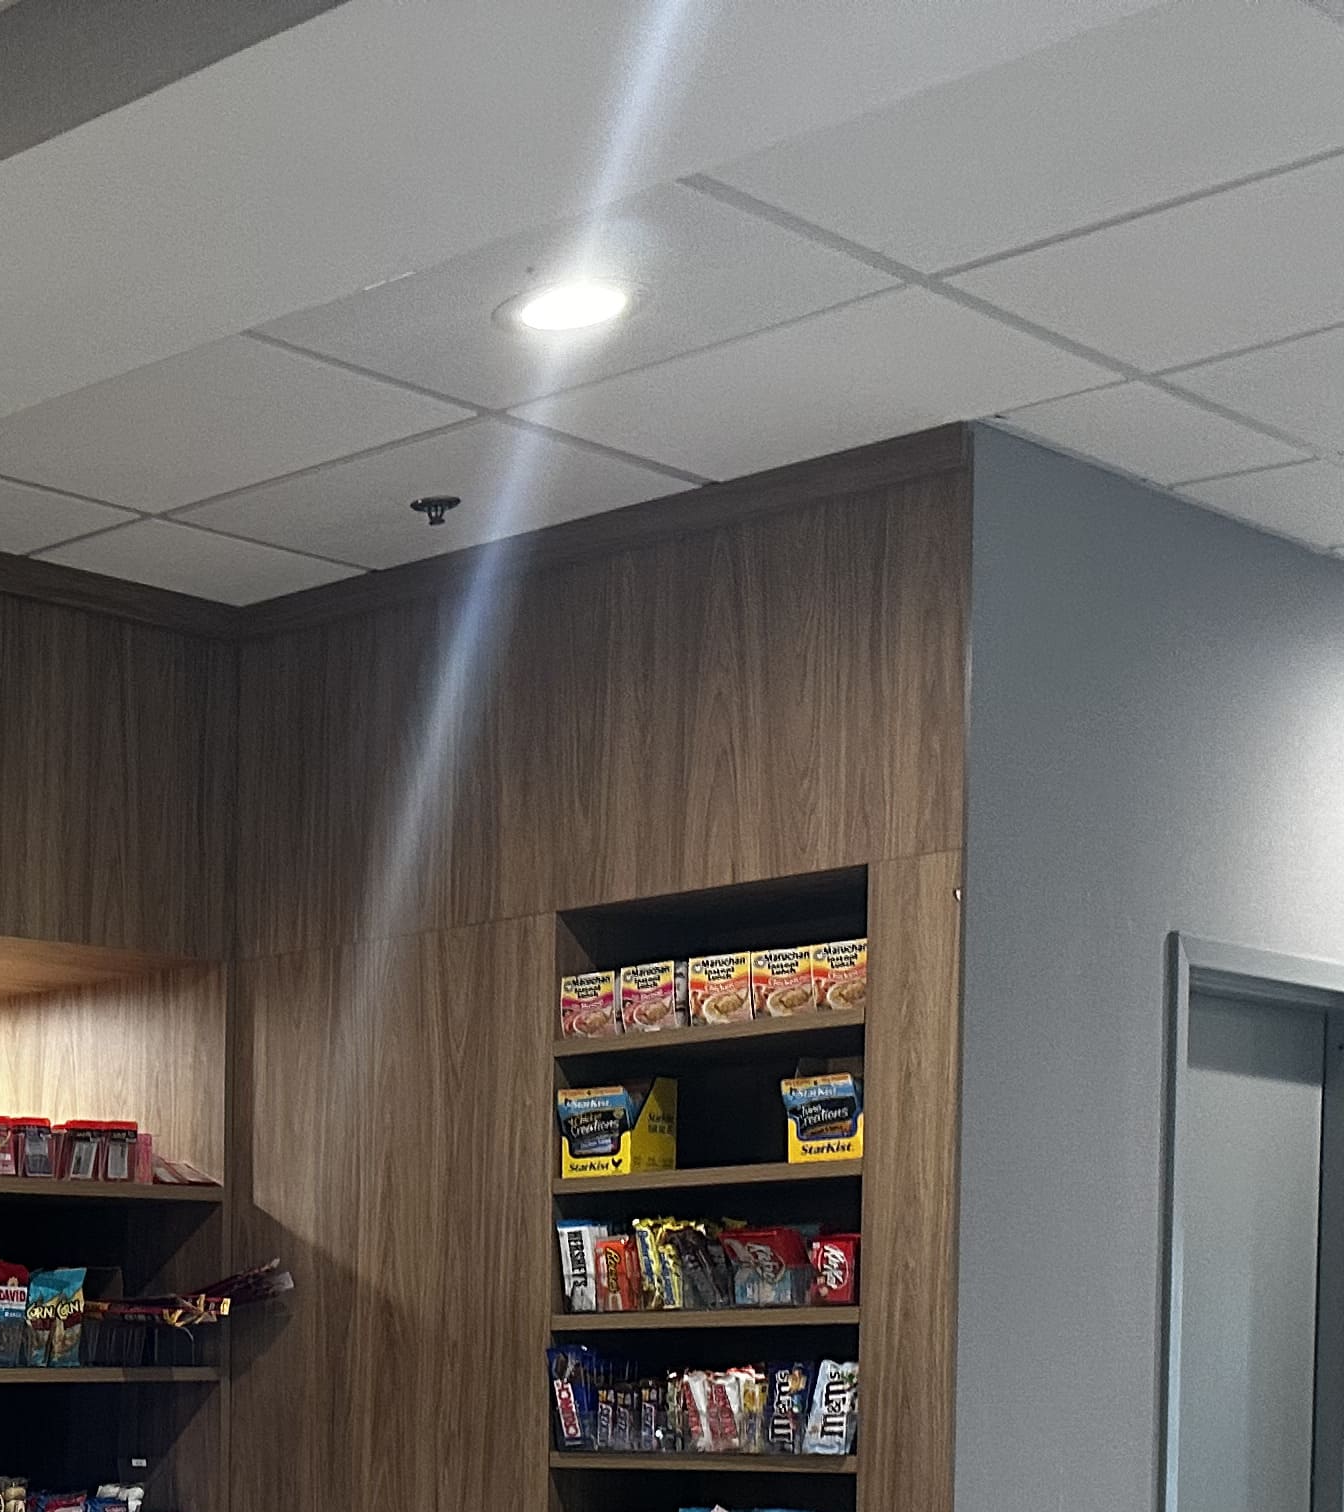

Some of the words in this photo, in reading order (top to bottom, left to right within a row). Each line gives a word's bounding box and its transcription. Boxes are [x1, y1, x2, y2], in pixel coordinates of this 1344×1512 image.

[764, 951, 810, 962] Maruchan
[701, 957, 746, 968] Maruchan
[800, 1140, 852, 1156] StarKist
[568, 1160, 610, 1172] StarKist
